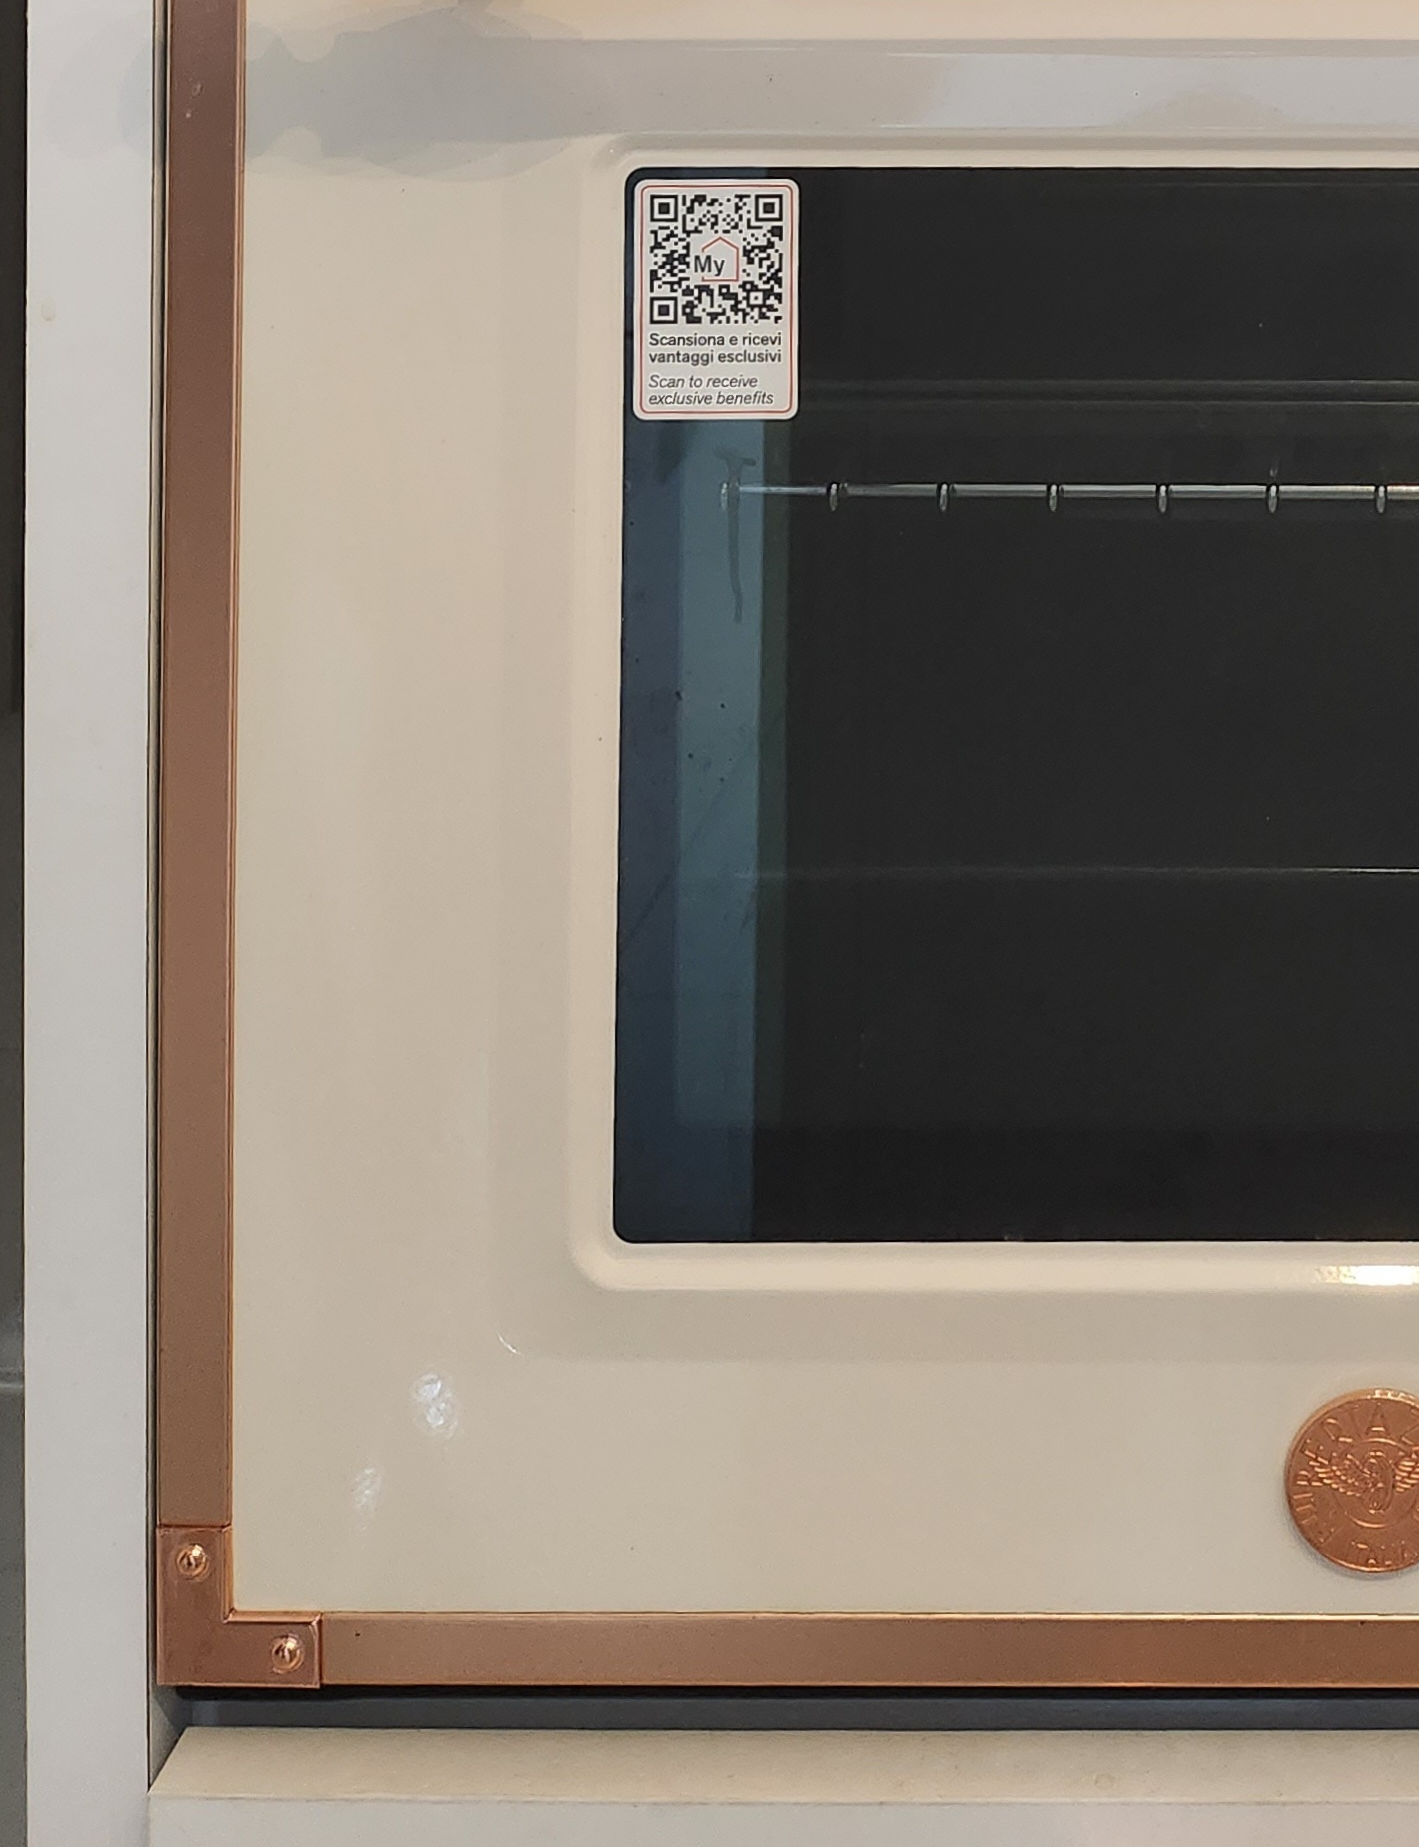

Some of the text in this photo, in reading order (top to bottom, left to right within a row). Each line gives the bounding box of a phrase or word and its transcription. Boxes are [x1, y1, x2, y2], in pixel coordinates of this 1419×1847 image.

[694, 255, 725, 277] My
[649, 332, 782, 346] Scansiona e ricevi
[649, 349, 782, 366] vantaggi esclusivi
[649, 374, 758, 388] Scan to receive
[649, 391, 774, 405] exclusive benefits
